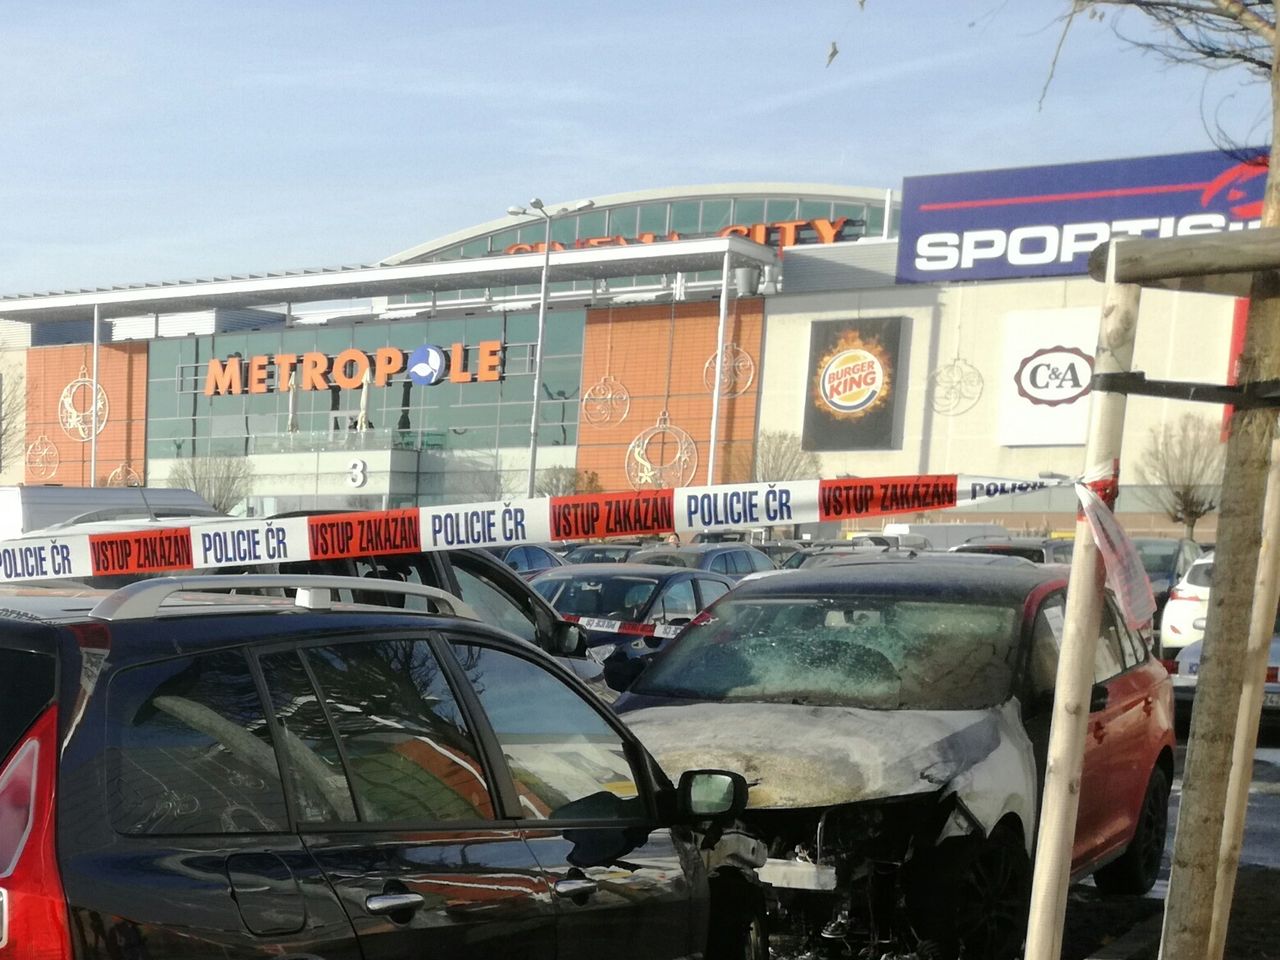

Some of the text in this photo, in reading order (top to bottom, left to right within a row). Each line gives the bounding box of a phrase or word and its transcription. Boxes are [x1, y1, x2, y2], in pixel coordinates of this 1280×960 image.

[915, 213, 1262, 271] SPORTIS
[828, 360, 875, 384] BURGER
[828, 371, 877, 400] KING
[1029, 362, 1082, 389] C&A
[347, 458, 367, 488] 3
[50, 539, 73, 576] ČR
[91, 539, 132, 572] VSTUP
[134, 530, 191, 569] ZAKÁZÁN
[201, 528, 262, 564] POLICIE
[265, 521, 288, 559] ČR
[309, 521, 353, 556] VSTUP
[357, 511, 419, 552] ZAKÁZÁN
[431, 509, 497, 547] POLICIE
[502, 502, 527, 542] ČR
[552, 501, 600, 538] VSTUP
[604, 491, 672, 534] ZAKÁZÁN
[687, 490, 759, 528] POLICIE
[764, 483, 793, 521] ČR
[821, 484, 873, 517] VSTUP
[879, 476, 955, 512] ZAKÁZÁN
